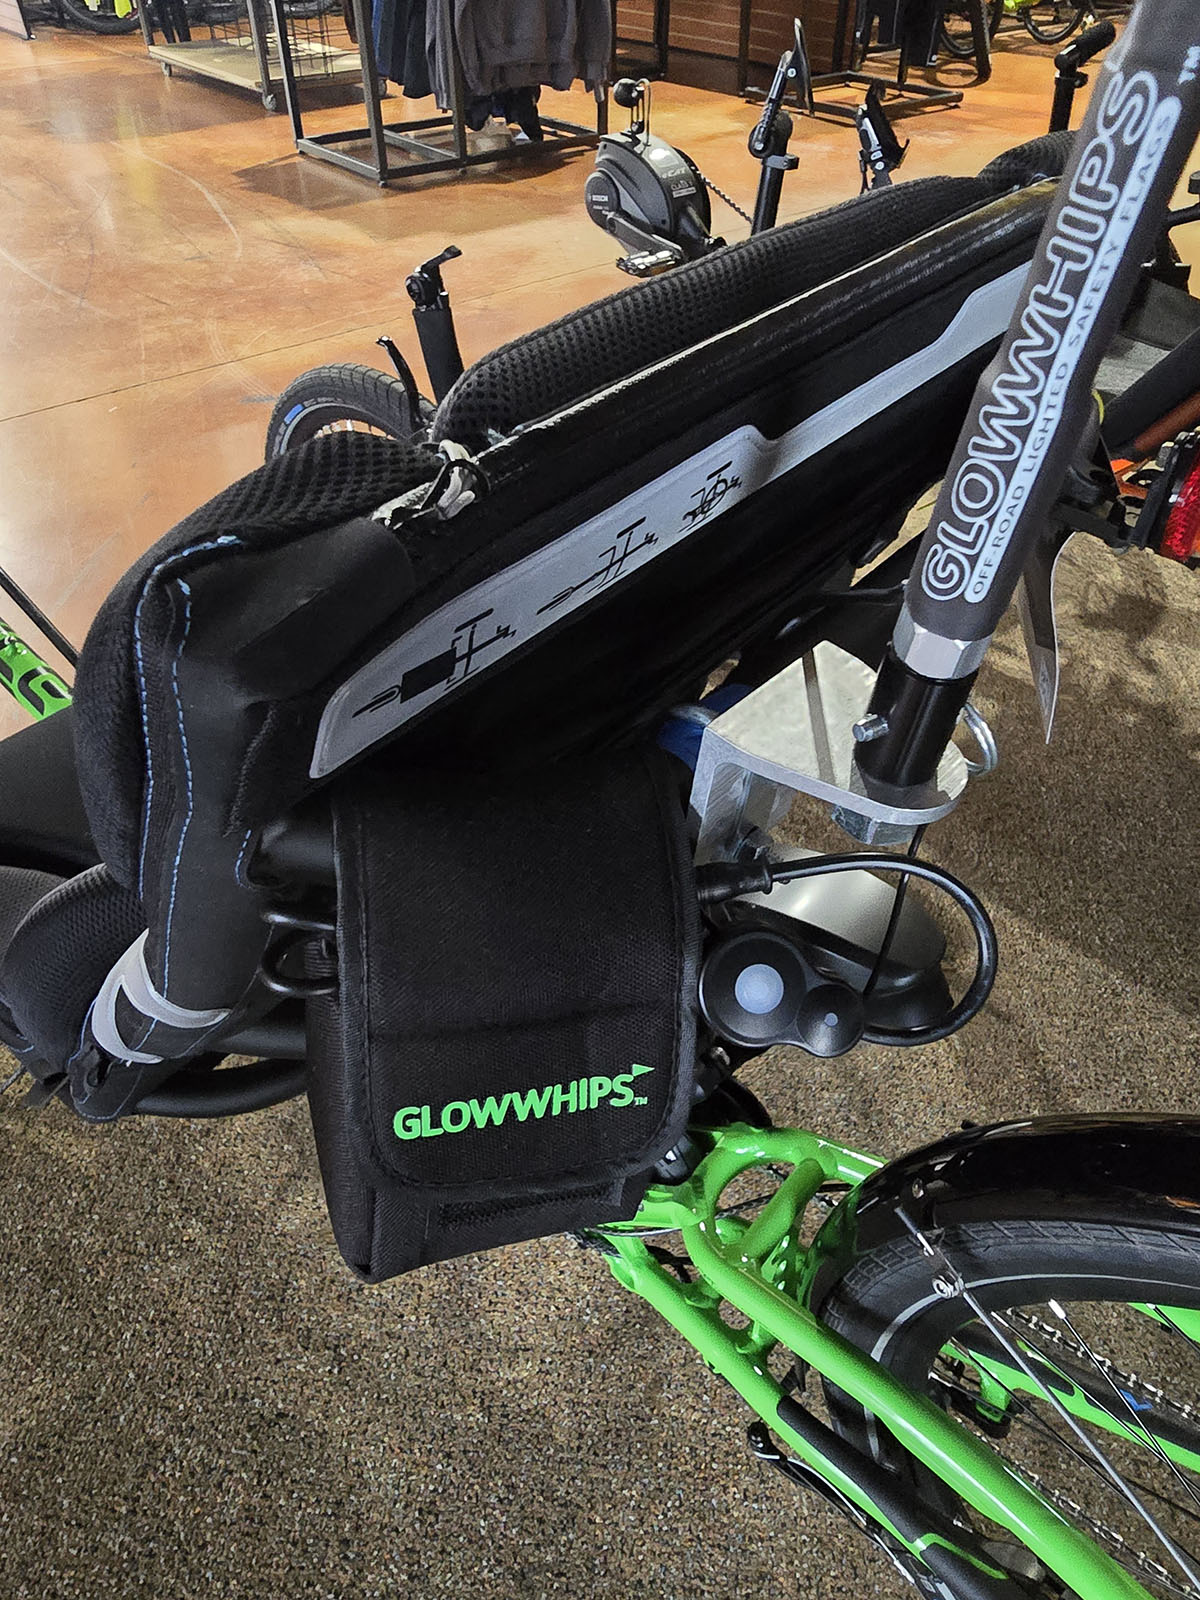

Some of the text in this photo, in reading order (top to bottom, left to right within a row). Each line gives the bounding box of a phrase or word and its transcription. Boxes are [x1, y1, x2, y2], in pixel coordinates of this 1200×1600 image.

[921, 70, 1158, 601] GLOWWHIPS
[972, 114, 1171, 595] OFF-ROAD LIGHTED SAFETY FLAGS
[393, 1073, 635, 1140] GLOWWHIPS
